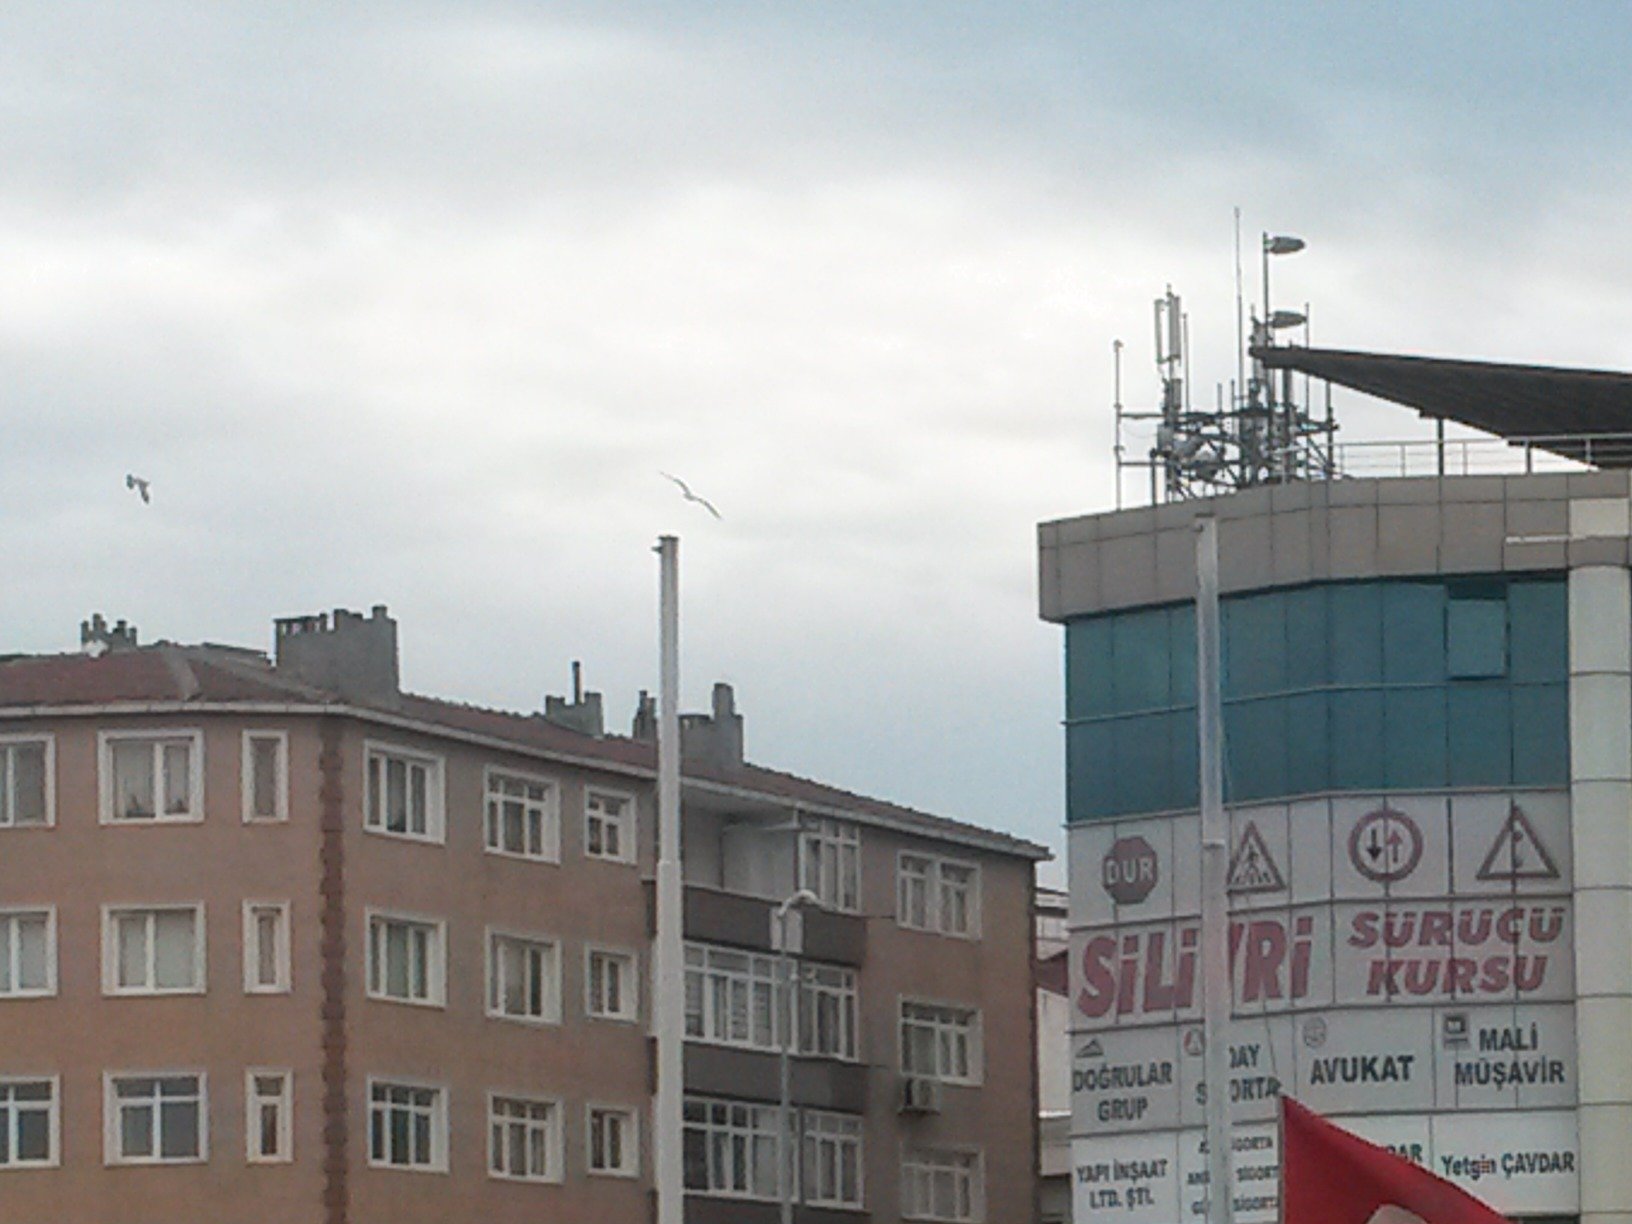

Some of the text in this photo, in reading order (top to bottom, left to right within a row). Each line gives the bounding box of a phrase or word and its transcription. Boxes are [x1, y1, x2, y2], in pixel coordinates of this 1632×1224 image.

[1104, 854, 1154, 885] DUR
[1348, 906, 1567, 949] SÜRÜCÜ
[1366, 955, 1548, 996] KURSU
[1479, 1022, 1539, 1051] MALİ
[1072, 1061, 1173, 1093] DOĞRULAR
[1311, 1055, 1416, 1085] AVUKAT
[1098, 1096, 1149, 1123] GRUP
[1501, 1151, 1575, 1179] ÇAVDAR
